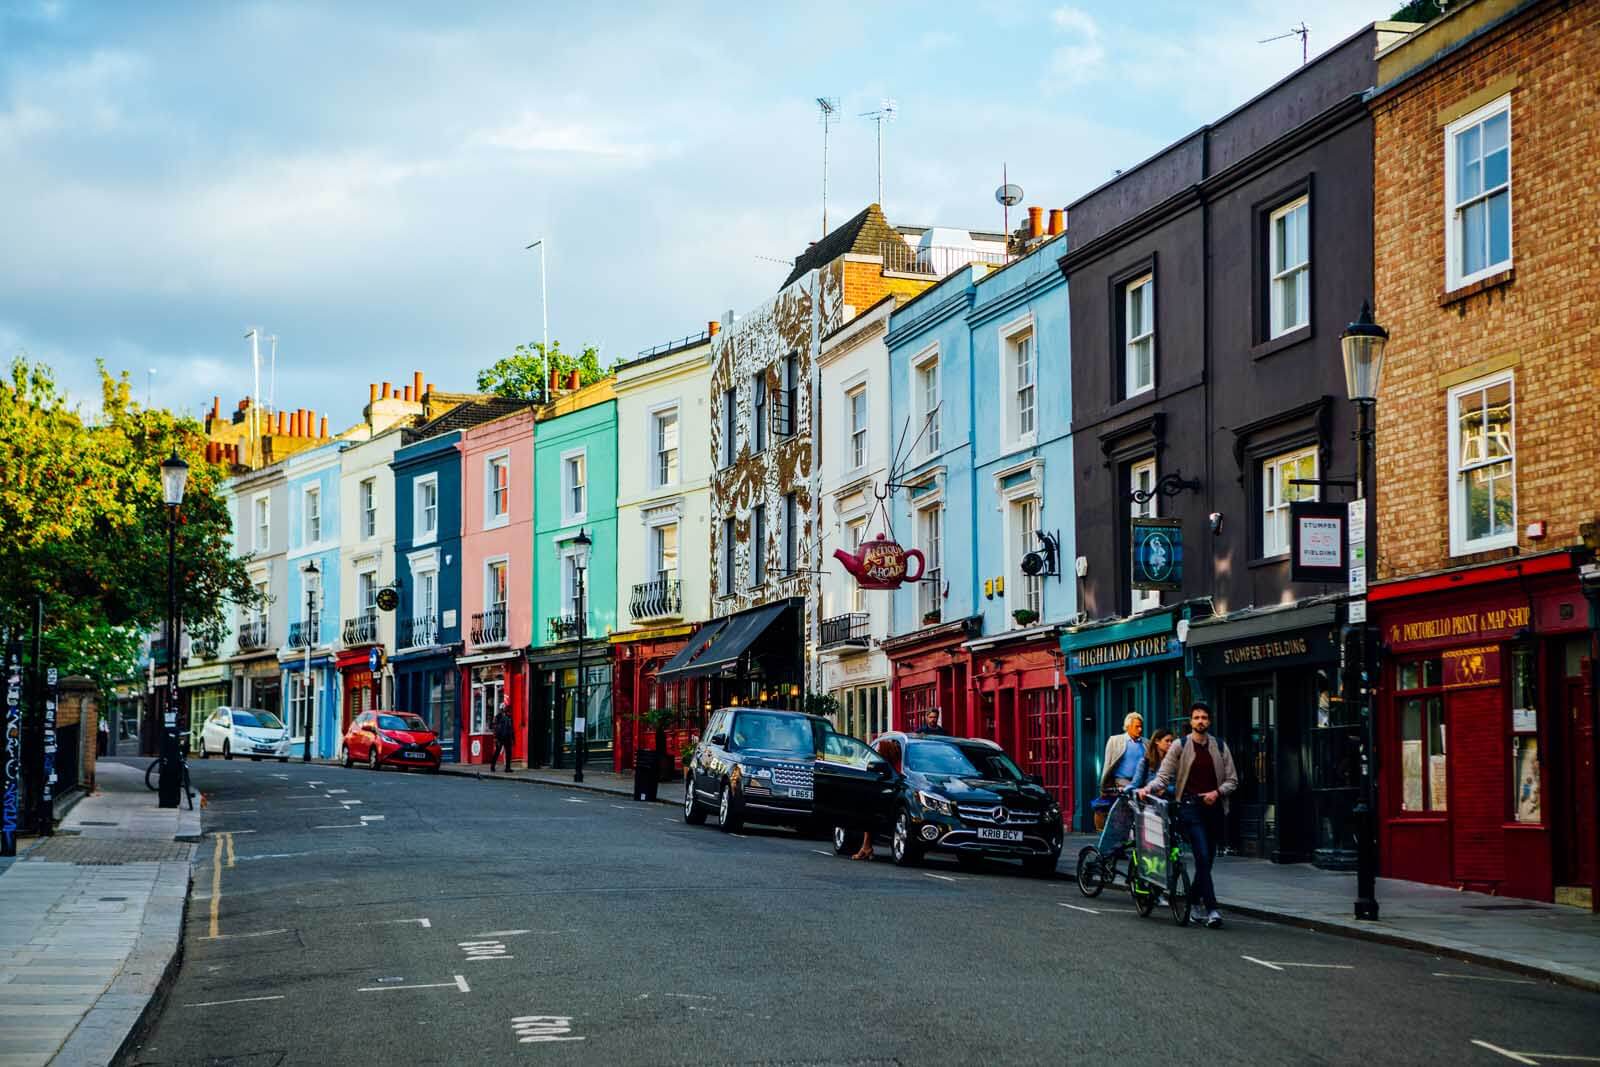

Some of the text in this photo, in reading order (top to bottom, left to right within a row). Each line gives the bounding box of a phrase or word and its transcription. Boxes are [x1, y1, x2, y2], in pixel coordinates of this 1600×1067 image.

[1303, 521, 1337, 529] STUMPER
[1403, 618, 1451, 641] PORTOBELLO
[1452, 613, 1478, 635] PRINT
[1487, 609, 1508, 631] MAP
[1508, 606, 1531, 628] SHOP
[1079, 635, 1167, 668] HIGHLAND STORE
[1266, 637, 1307, 658] FIELDING
[982, 827, 1018, 840] KR18 BCY
